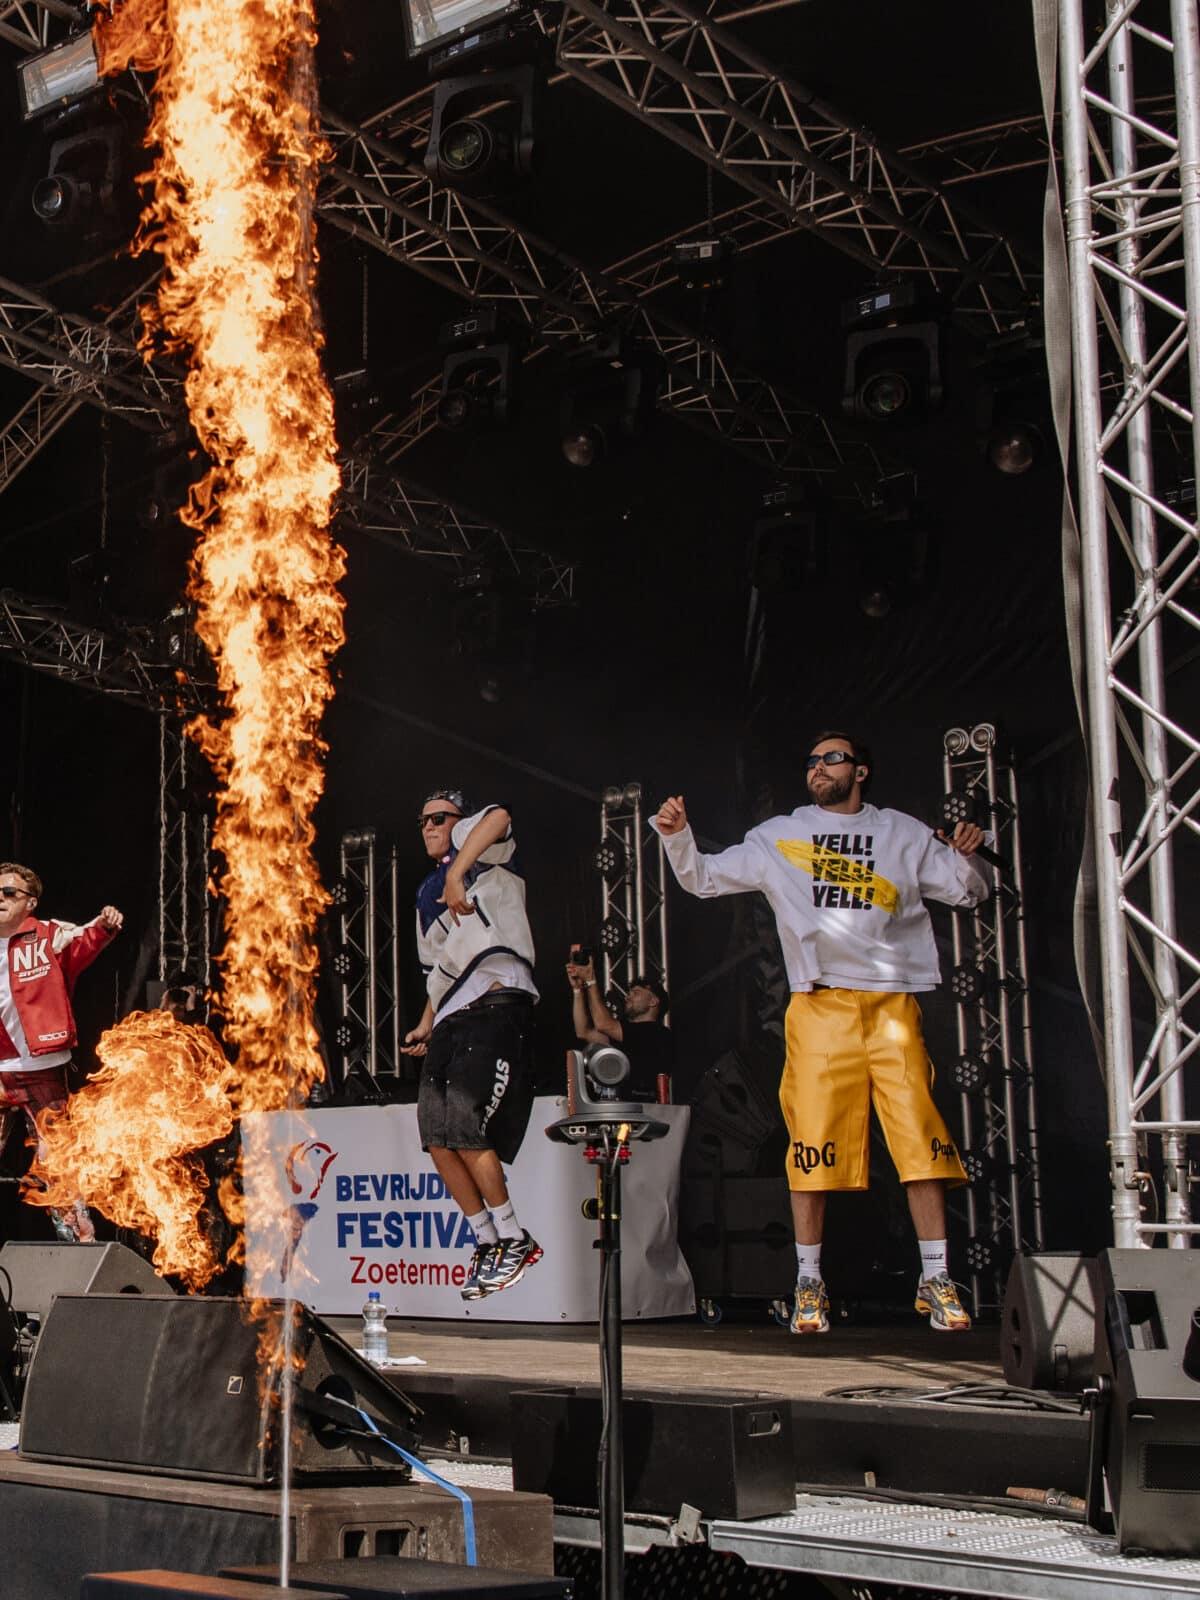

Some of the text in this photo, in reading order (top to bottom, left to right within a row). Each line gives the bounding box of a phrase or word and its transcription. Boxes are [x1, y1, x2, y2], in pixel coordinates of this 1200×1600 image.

[812, 833, 874, 857] YELL!
[812, 858, 876, 884] YELL!
[812, 885, 876, 911] YELL!
[13, 938, 51, 973] NK
[793, 1140, 836, 1175] RDG
[337, 1211, 486, 1249] FESTIVA
[350, 1256, 473, 1286] Zoeterme
